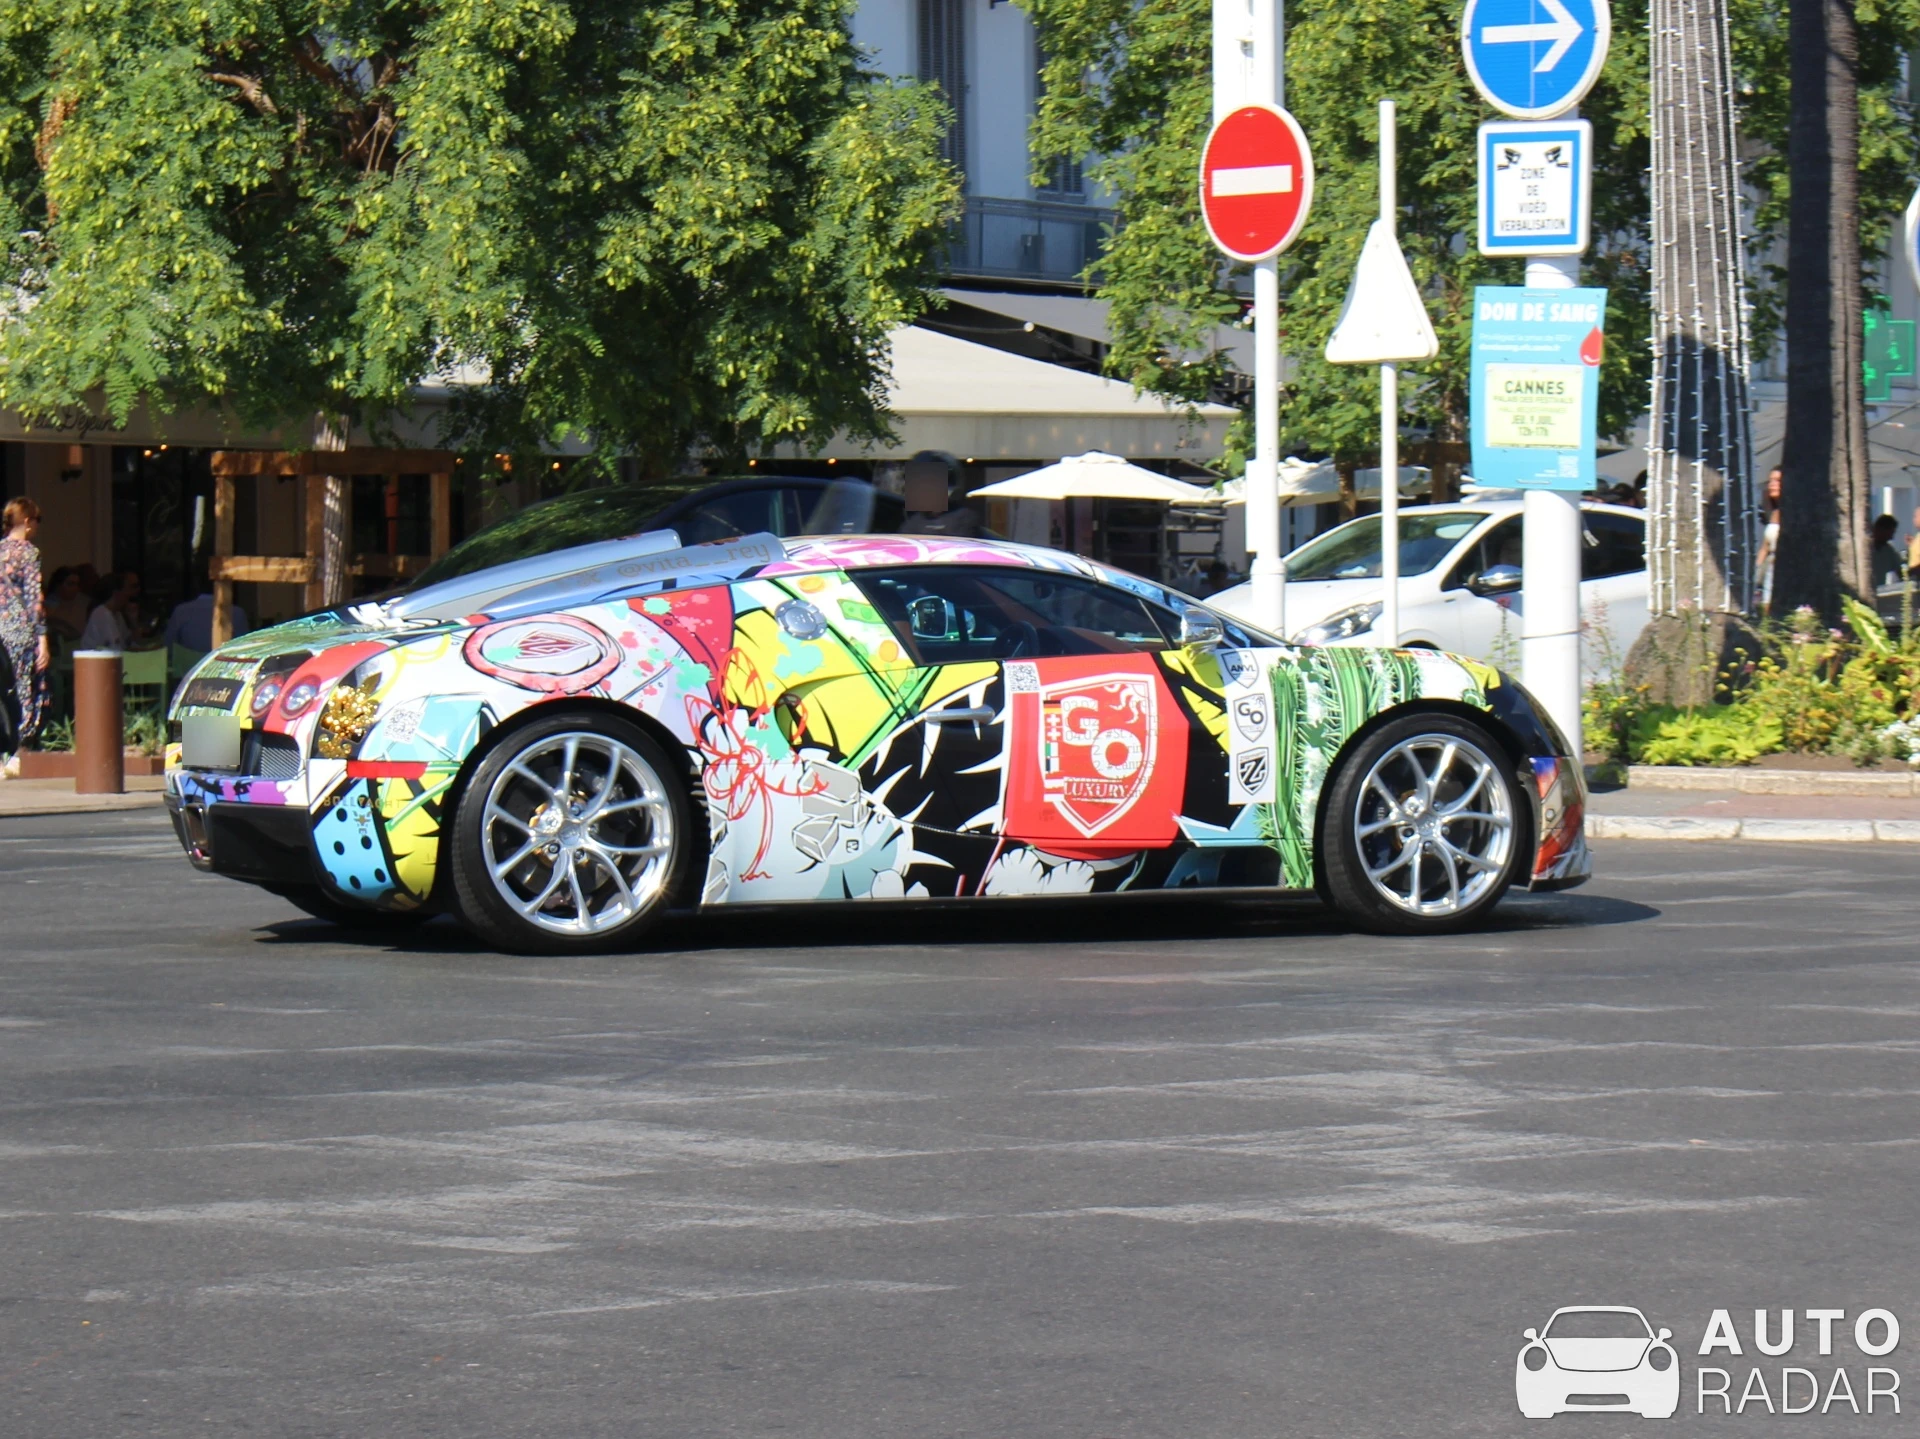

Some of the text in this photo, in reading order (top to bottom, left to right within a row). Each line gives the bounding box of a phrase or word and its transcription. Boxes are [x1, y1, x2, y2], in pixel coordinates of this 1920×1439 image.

[1520, 167, 1545, 180] ZONE
[1526, 184, 1539, 196] DE
[1500, 218, 1566, 231] VERBALISATION
[1480, 302, 1598, 322] DON DE SANG
[1504, 380, 1565, 395] CANNES
[1230, 664, 1256, 673] ANVL
[1237, 702, 1264, 725] GO
[1064, 781, 1129, 798] LUXURY
